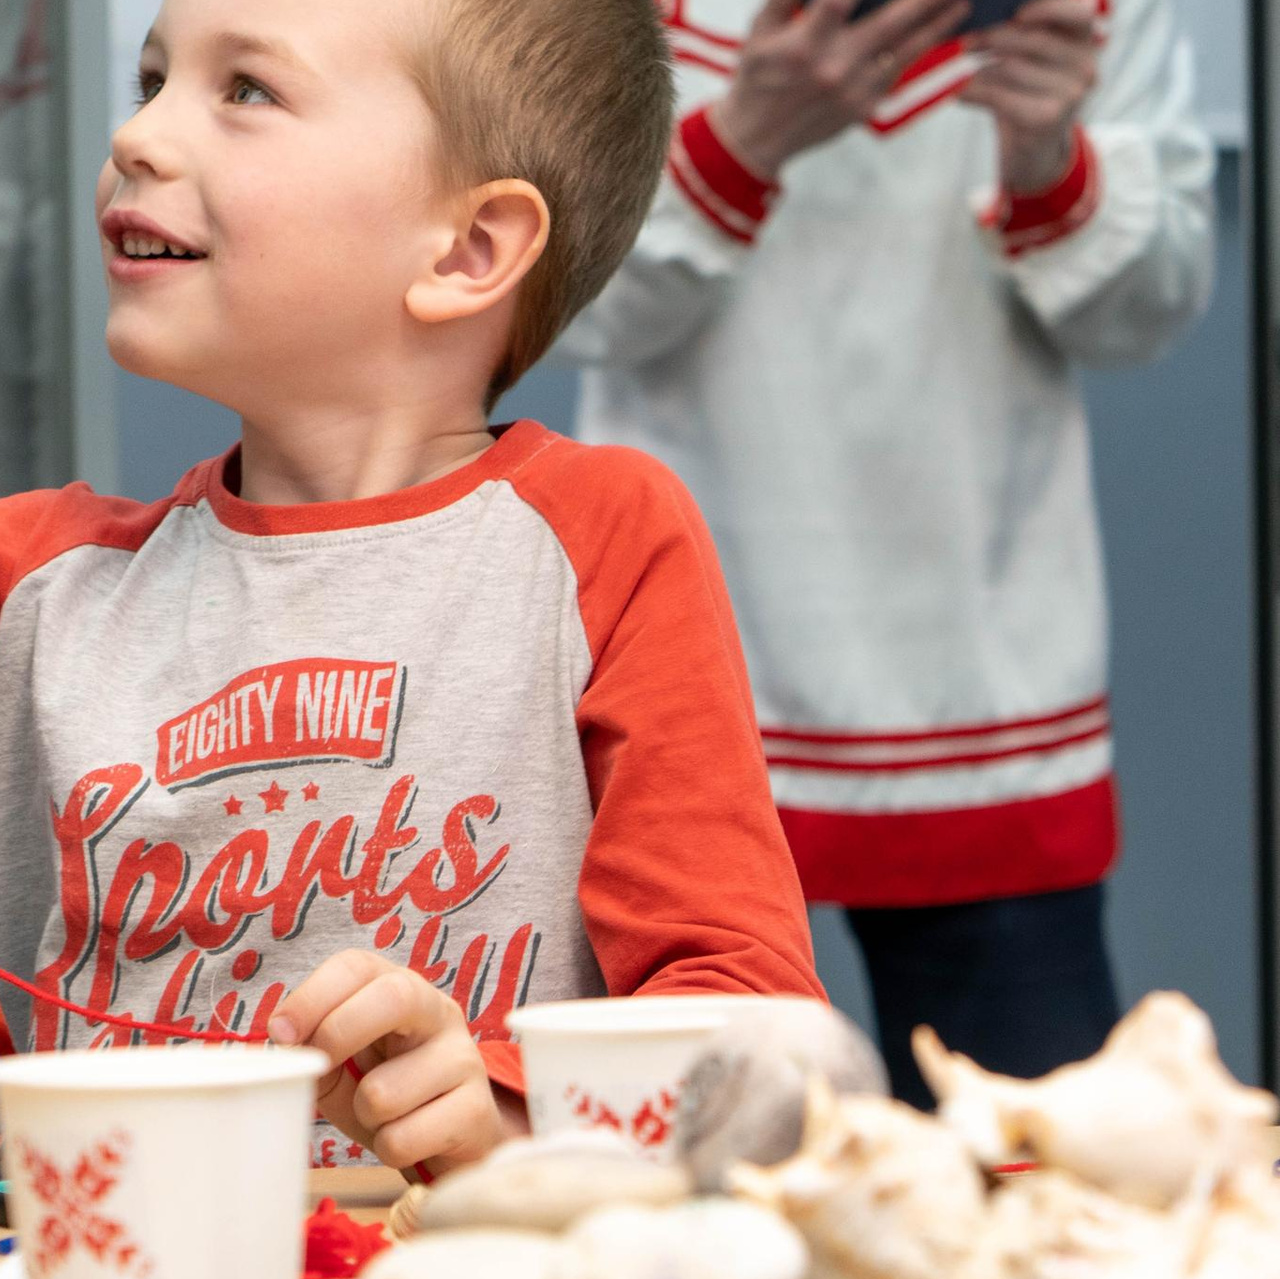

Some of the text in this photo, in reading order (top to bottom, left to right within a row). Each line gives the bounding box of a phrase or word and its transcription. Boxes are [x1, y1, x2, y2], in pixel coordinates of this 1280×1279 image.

[168, 667, 395, 775] EIGHTY NINE
[33, 763, 511, 1049] Sports
